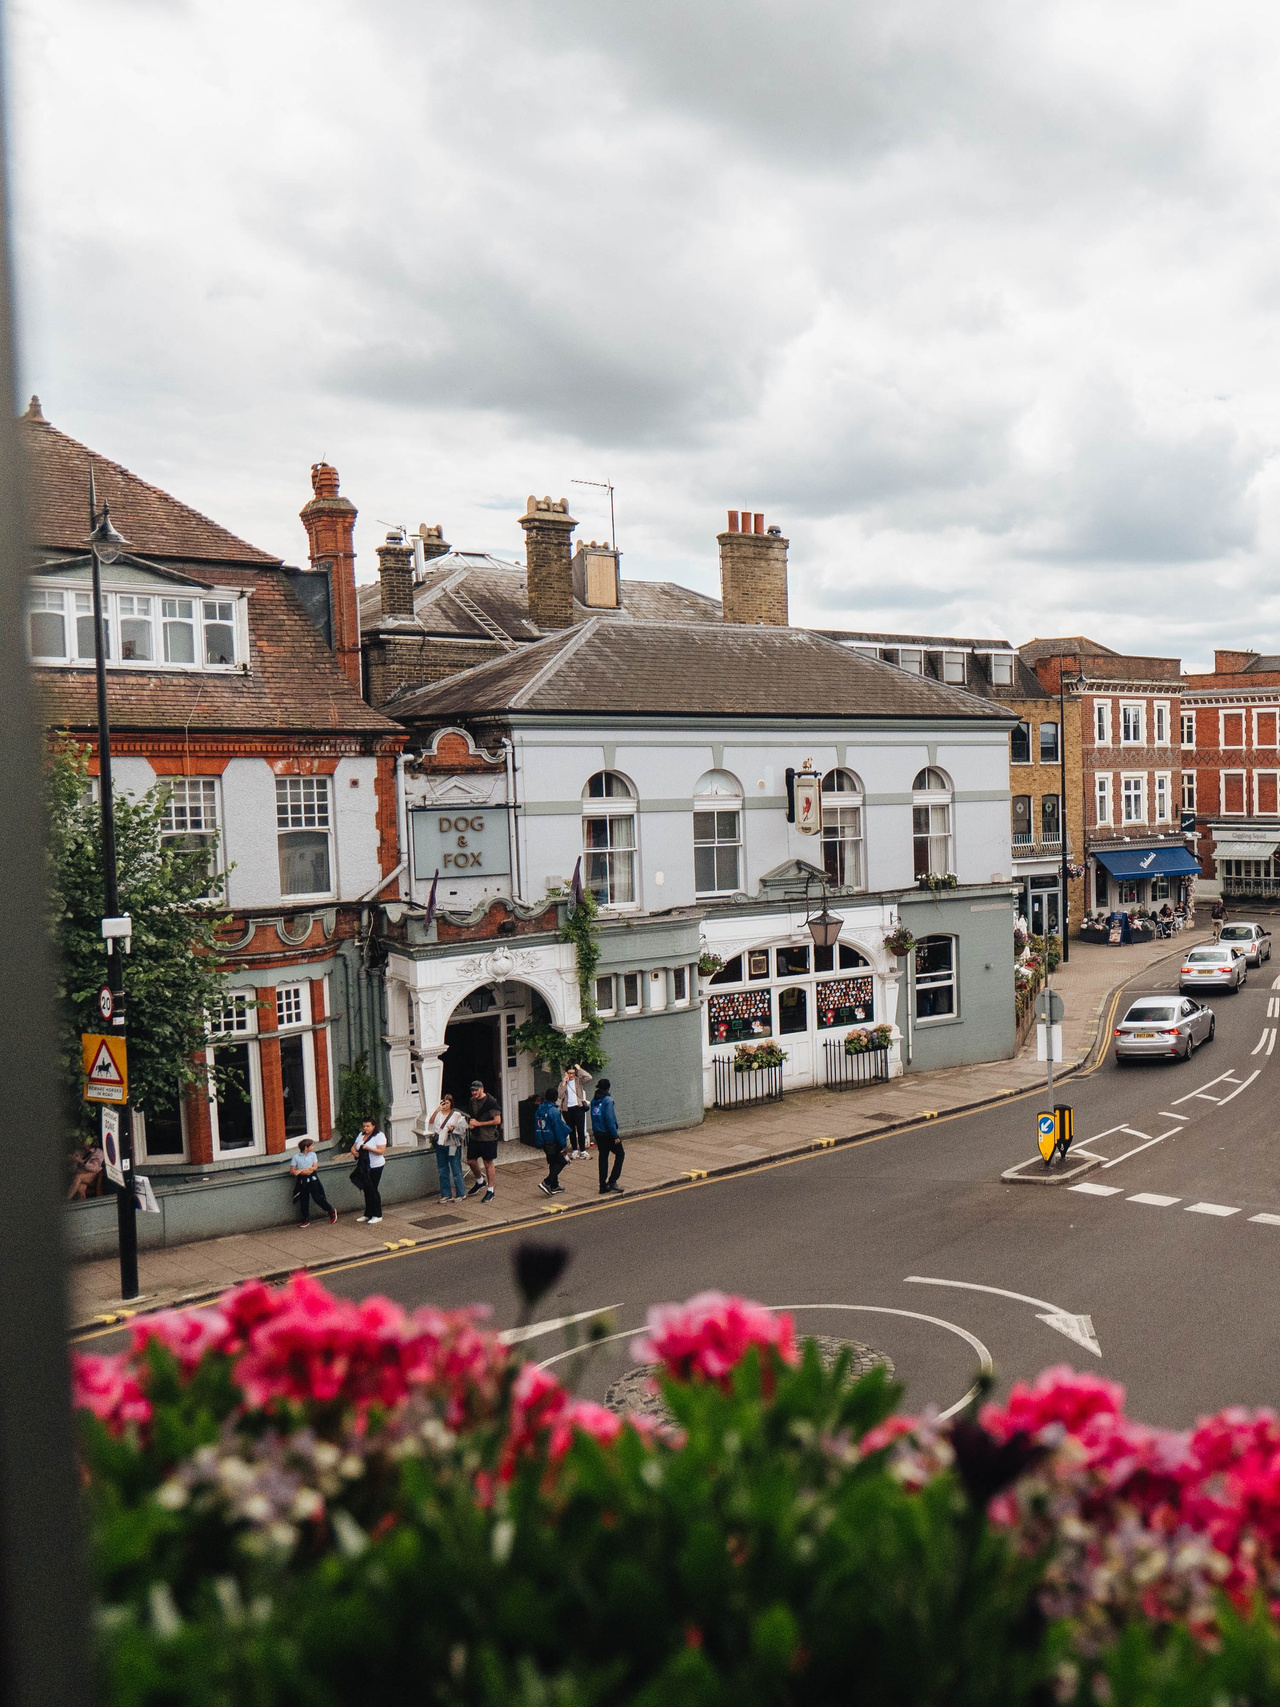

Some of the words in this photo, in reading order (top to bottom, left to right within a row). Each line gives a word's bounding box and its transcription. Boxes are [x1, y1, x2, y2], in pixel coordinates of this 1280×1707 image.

[439, 816, 485, 832] DOG
[457, 835, 468, 847] &
[443, 852, 482, 868] FOX
[101, 996, 111, 1011] 20
